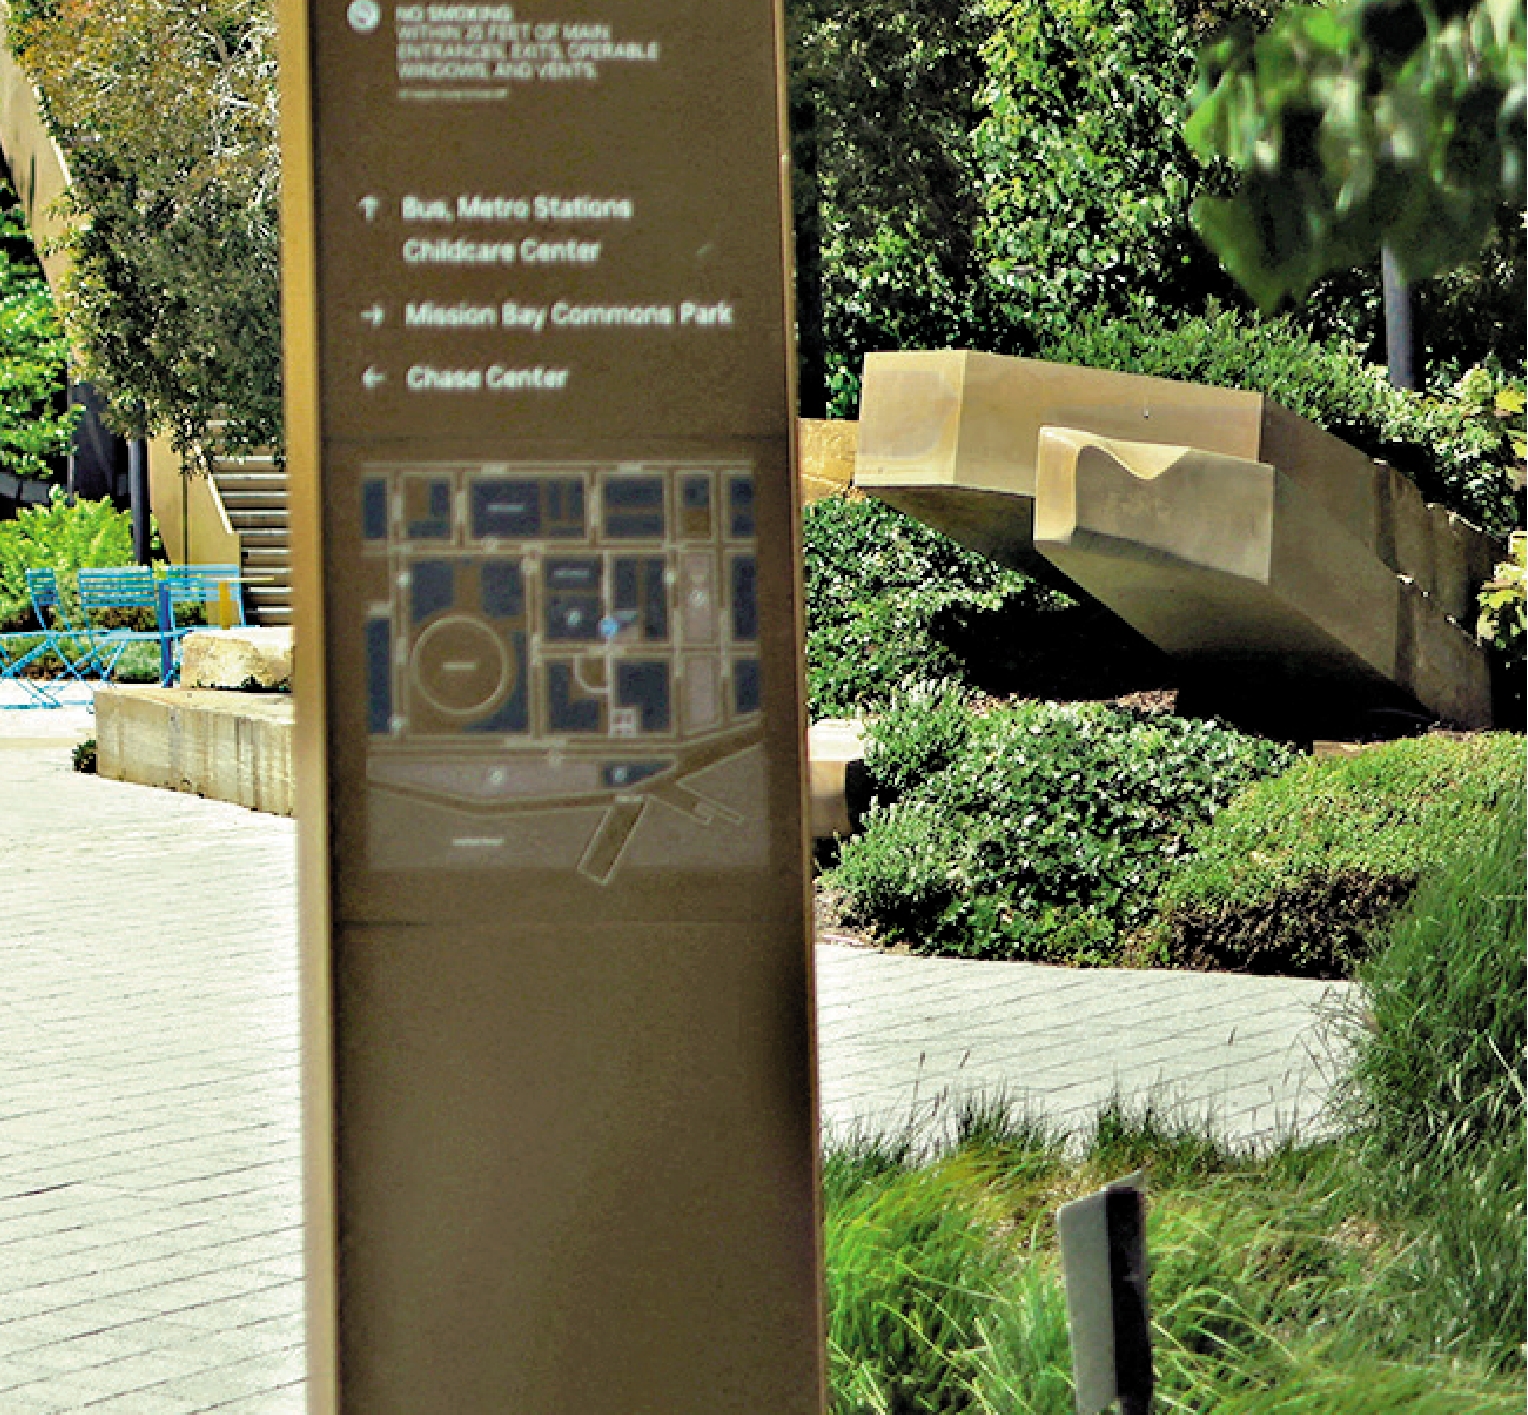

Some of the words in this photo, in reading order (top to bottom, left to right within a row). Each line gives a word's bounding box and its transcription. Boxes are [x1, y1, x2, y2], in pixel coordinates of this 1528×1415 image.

[401, 196, 454, 222] Bus,
[456, 196, 529, 220] Metro
[533, 196, 634, 221] Stations
[402, 238, 515, 263] Childcare
[520, 238, 601, 263] Center
[405, 301, 497, 326] Mission
[501, 301, 544, 332] Bay
[550, 300, 674, 326] Commons
[679, 301, 734, 326] Park
[407, 365, 482, 390] Chase
[486, 365, 570, 390] Center
